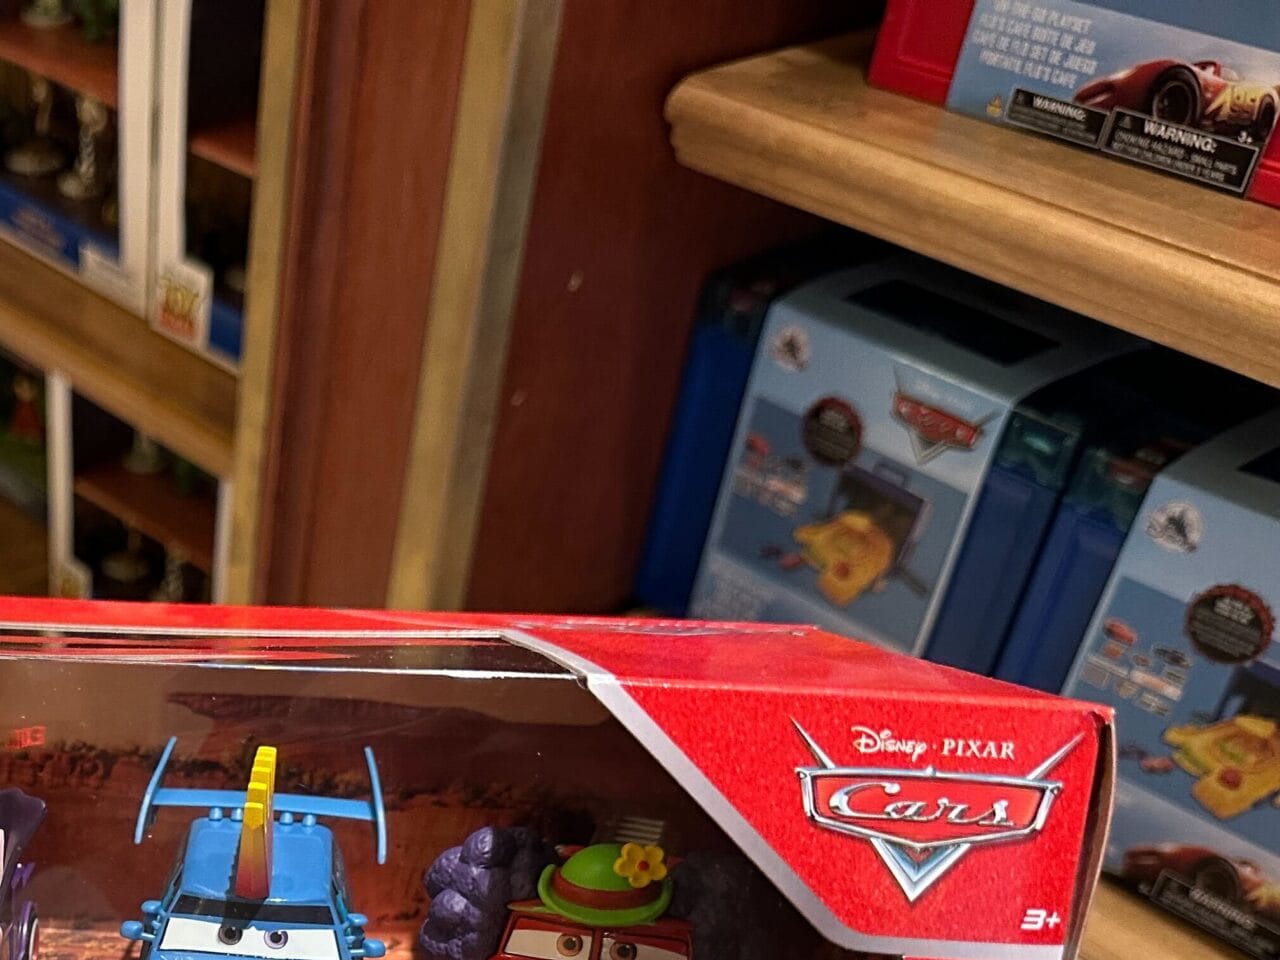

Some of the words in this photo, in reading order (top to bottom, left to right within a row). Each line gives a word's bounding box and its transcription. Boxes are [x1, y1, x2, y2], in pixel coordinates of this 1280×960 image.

[1143, 119, 1218, 154] WARNING:
[851, 725, 927, 763] Disney
[941, 737, 1015, 760] PIXAR
[828, 781, 1014, 827] Cars
[1020, 909, 1061, 930] 3+
